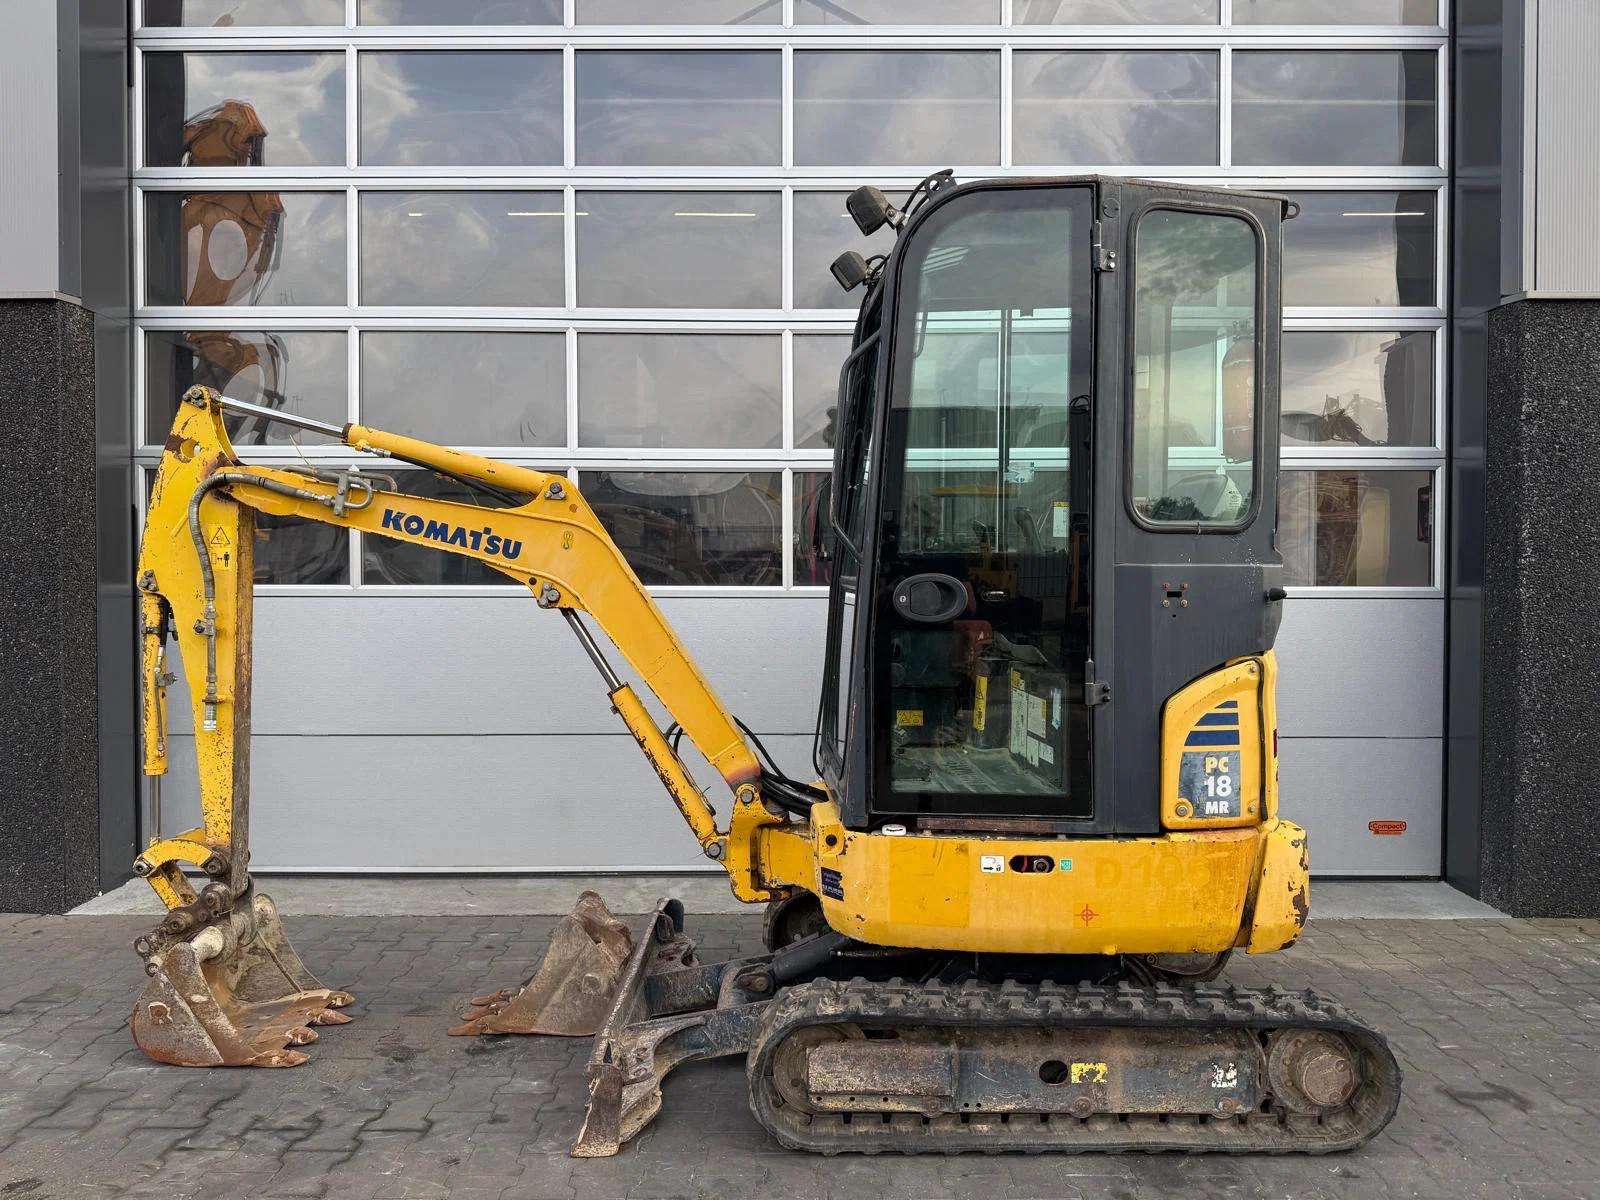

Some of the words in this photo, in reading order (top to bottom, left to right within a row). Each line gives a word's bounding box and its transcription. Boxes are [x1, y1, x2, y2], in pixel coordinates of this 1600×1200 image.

[381, 508, 522, 560] KOMATSU
[1205, 756, 1229, 774] PC
[1204, 775, 1233, 797] 18
[1205, 800, 1230, 815] MR
[1373, 822, 1403, 830] Compact
